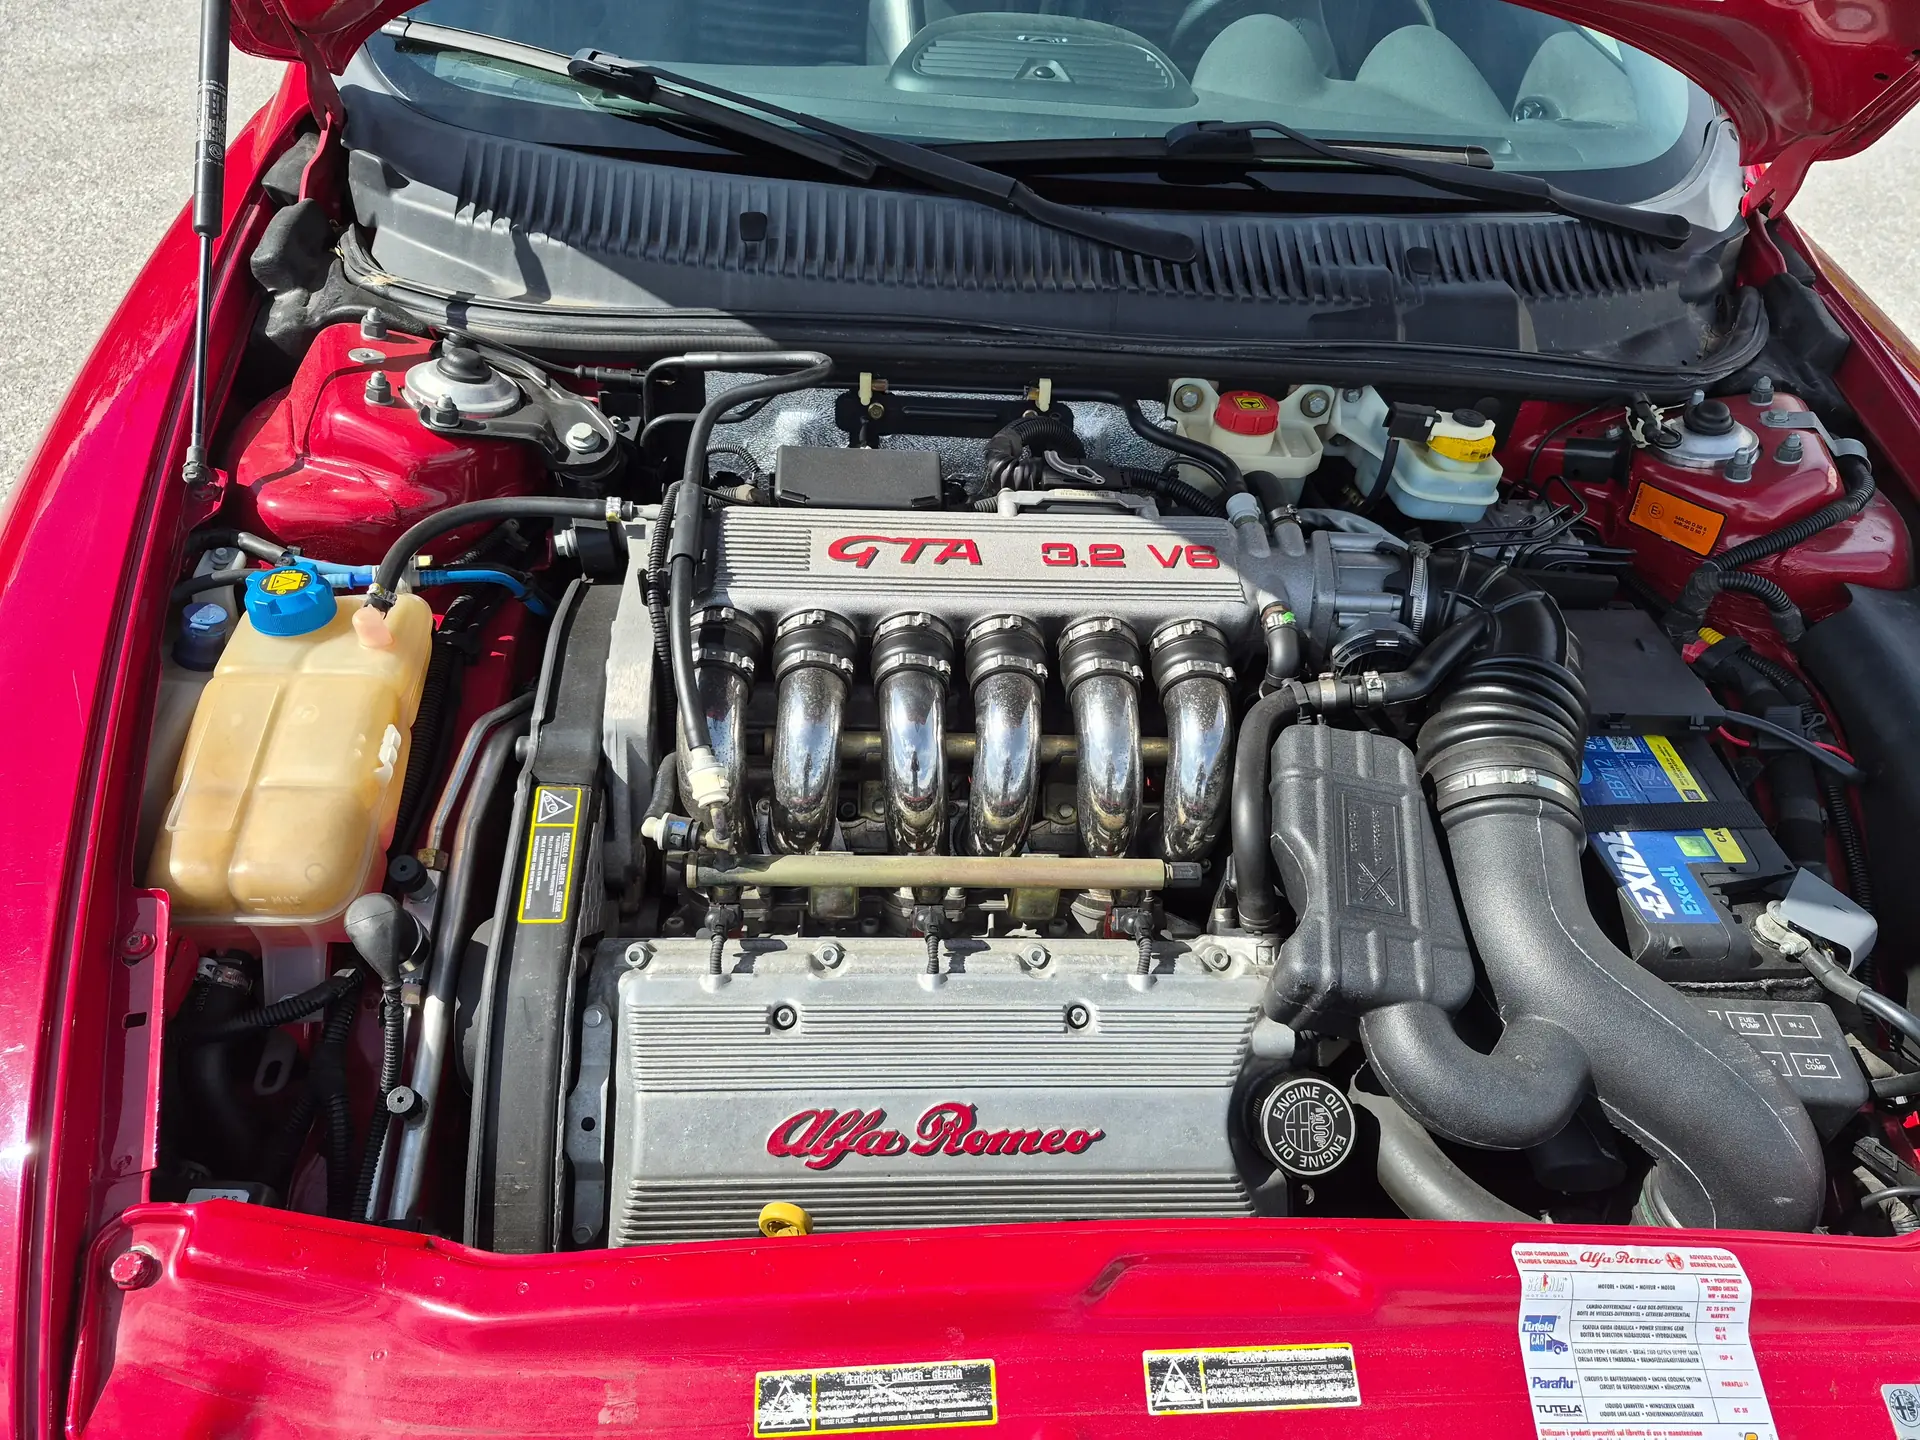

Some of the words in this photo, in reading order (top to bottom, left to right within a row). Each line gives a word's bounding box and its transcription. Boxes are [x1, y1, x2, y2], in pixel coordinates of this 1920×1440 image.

[827, 534, 983, 569] GTA
[1041, 542, 1127, 568] 3.2
[1146, 543, 1221, 570] V6
[1593, 758, 1632, 798] EB712
[562, 832, 571, 858] PERICOLO
[559, 864, 567, 885] DANGER
[1598, 831, 1675, 920] EXIDE
[555, 891, 563, 912] GEFAHR
[1658, 866, 1703, 915] Excell
[1272, 1085, 1321, 1119] ENGINE
[1324, 1093, 1344, 1118] OIL
[766, 1108, 906, 1169] Alfa
[908, 1101, 1104, 1156] Romeo
[1275, 1135, 1295, 1160] OIL
[1299, 1134, 1347, 1168] ENGINE
[1580, 1251, 1615, 1268] Alfa
[1615, 1251, 1664, 1265] Romeo
[1523, 1321, 1554, 1332] Tutela
[1531, 1334, 1544, 1345] CAR
[892, 1371, 923, 1382] DANGER
[931, 1369, 963, 1380] GEFAHR
[1532, 1376, 1574, 1389] Paraflu
[1536, 1404, 1582, 1413] TUTELA
[1540, 1428, 1565, 1436] Utilizzare
[1570, 1429, 1591, 1437] prodotti
[1592, 1429, 1615, 1437] prescritti
